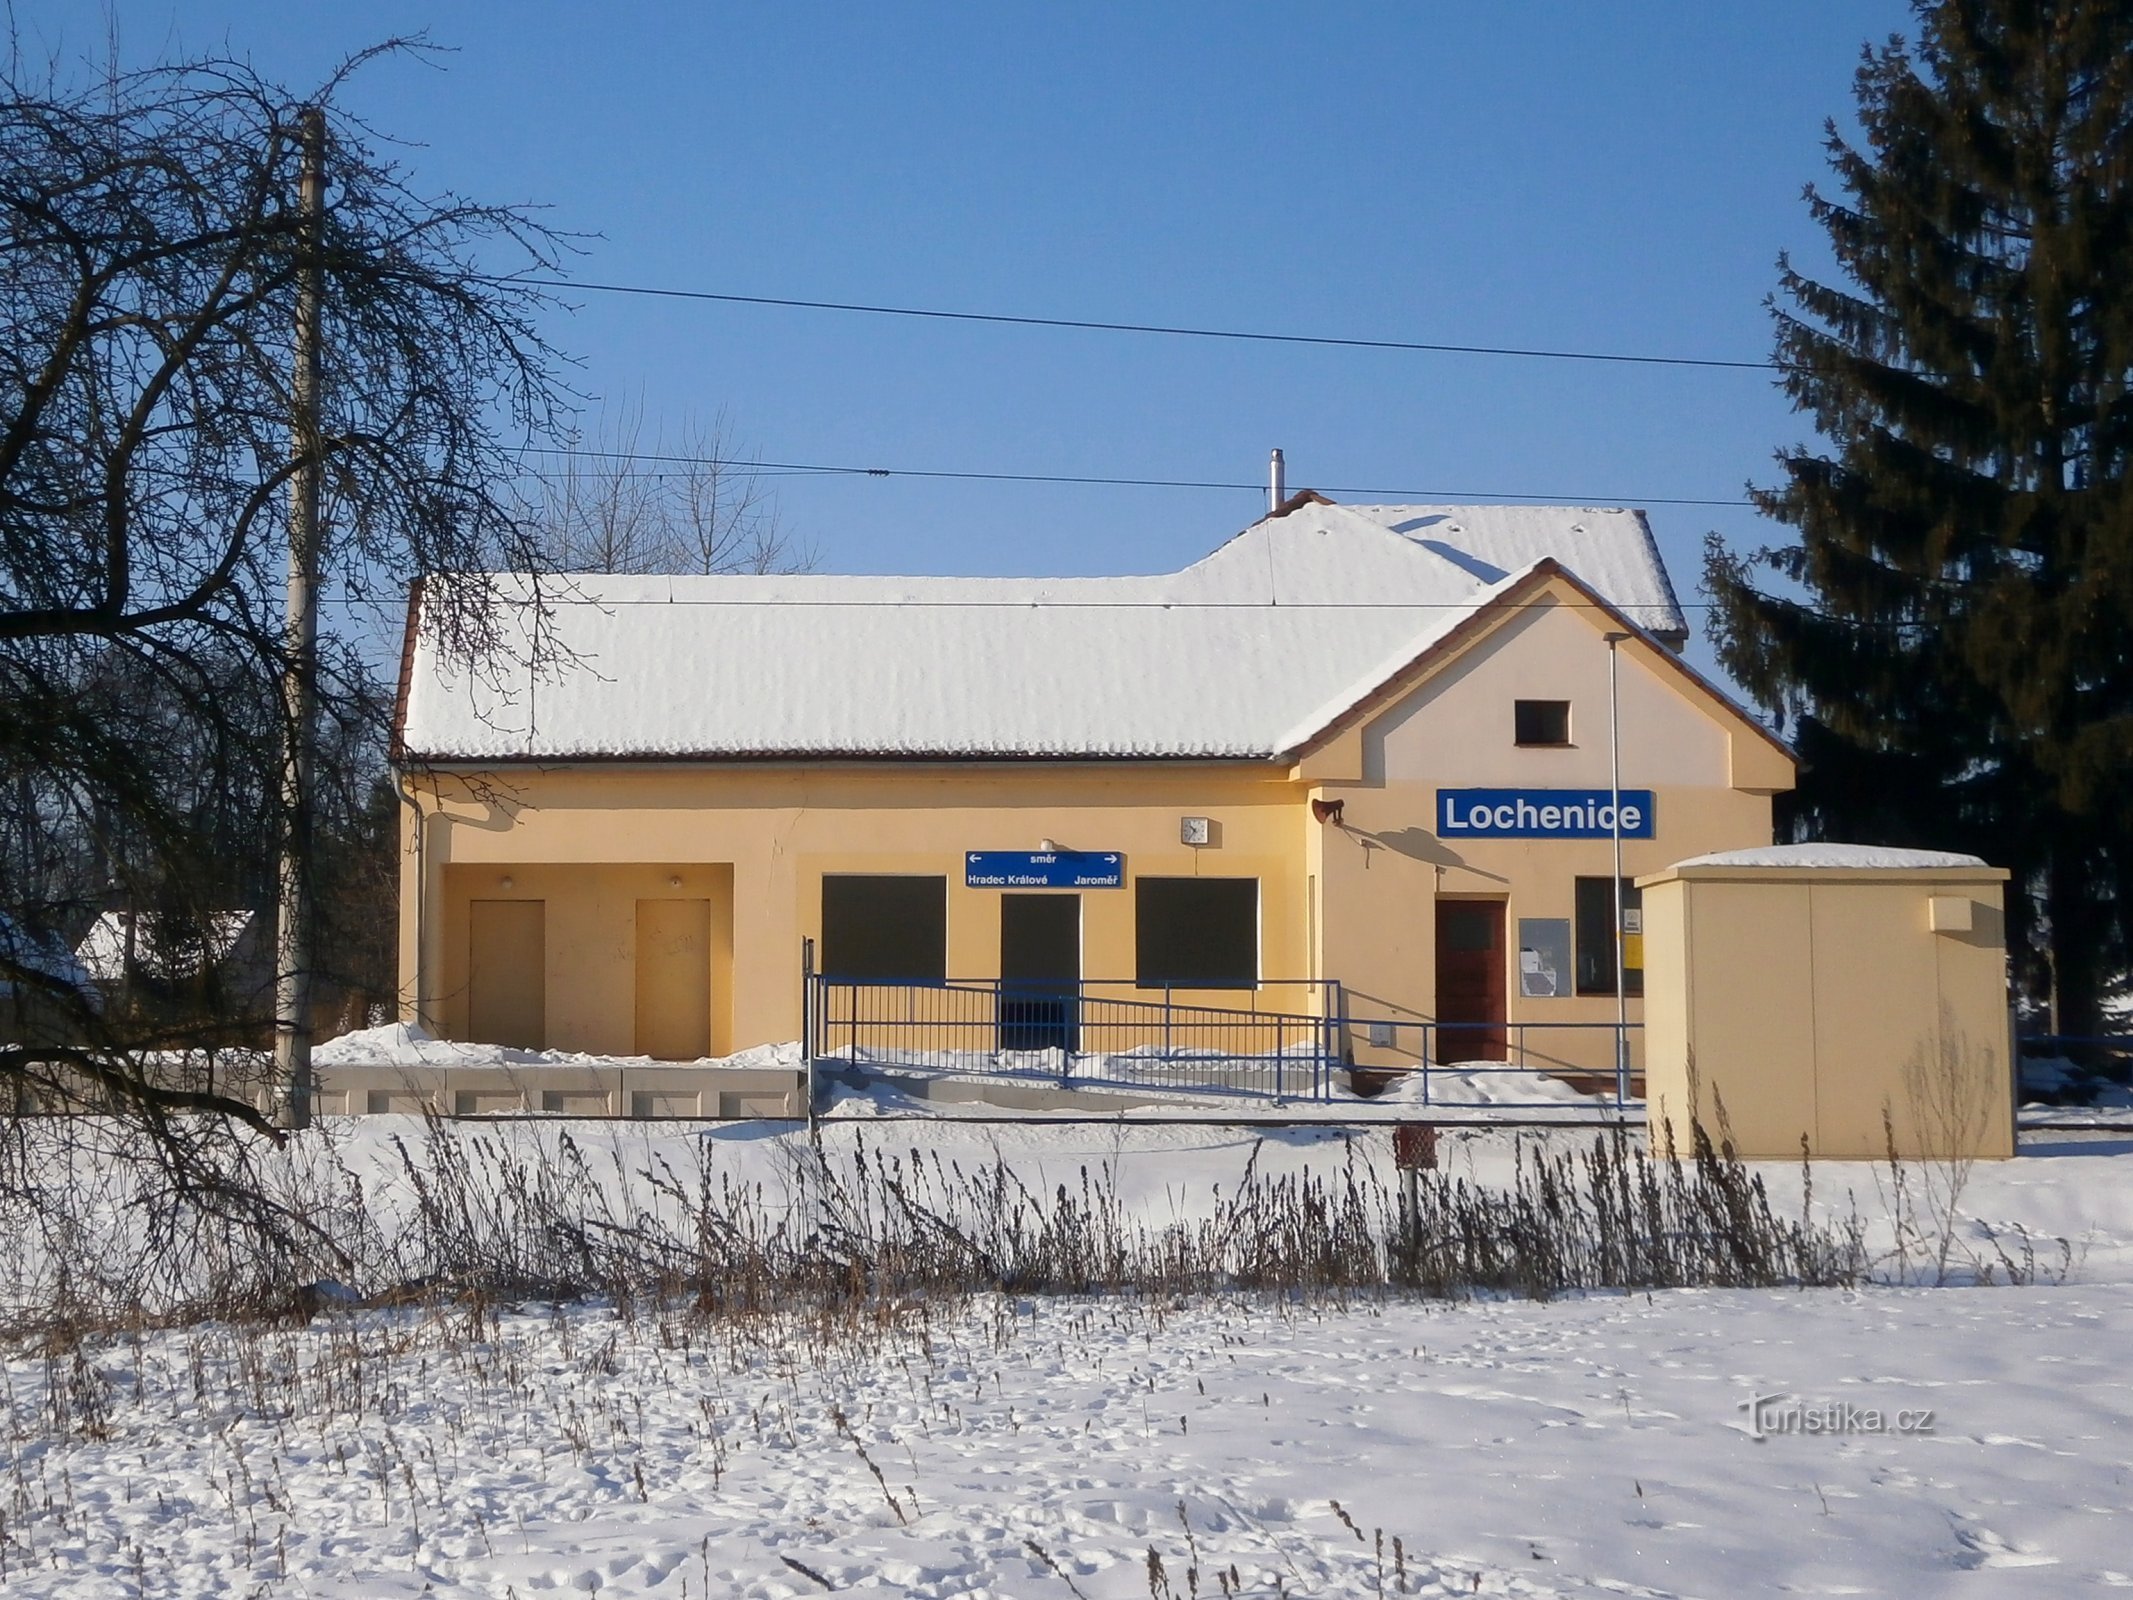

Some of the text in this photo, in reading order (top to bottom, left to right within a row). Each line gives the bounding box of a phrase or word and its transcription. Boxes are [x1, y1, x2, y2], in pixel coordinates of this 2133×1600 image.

[1446, 798, 1641, 830] Lochenice
[1030, 854, 1057, 863] směr
[968, 875, 1048, 885] Hradec Králové
[1074, 875, 1118, 885] Jaroměř
